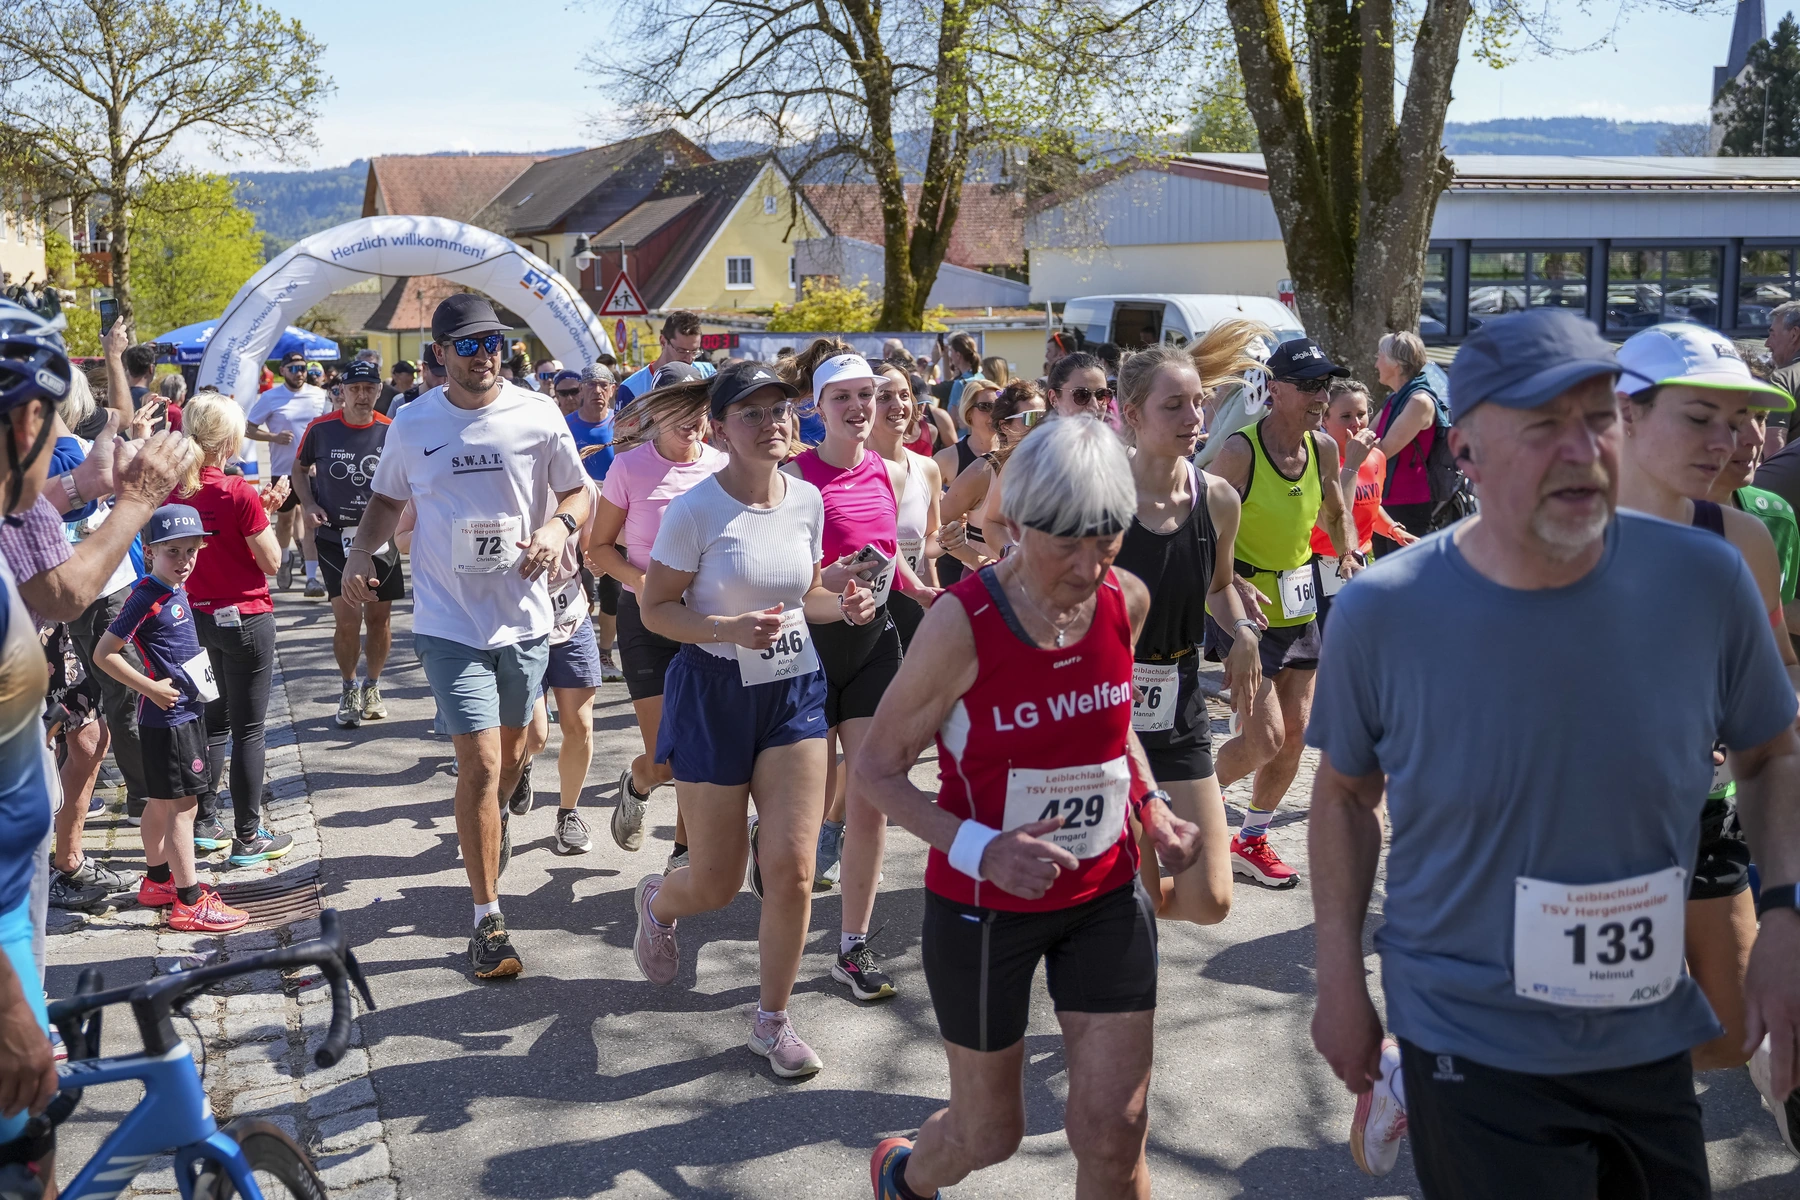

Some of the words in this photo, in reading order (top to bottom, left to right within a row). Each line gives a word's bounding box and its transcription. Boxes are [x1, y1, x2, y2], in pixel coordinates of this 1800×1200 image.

[331, 235, 387, 261] Herzlich
[391, 233, 486, 260] willkommen!
[556, 292, 588, 334] Volksbank
[215, 336, 238, 385] Volksbank
[330, 452, 355, 460] trophy
[452, 453, 503, 468] S.W.A.T.
[174, 517, 196, 526] FOX
[470, 521, 507, 529] Leiblachlauf
[476, 536, 502, 556] 72
[777, 658, 793, 666] Alina
[774, 667, 791, 677] AOK
[1133, 667, 1171, 675] eiblachlauf
[992, 702, 1040, 732] LG
[1047, 681, 1130, 721] Welfen
[1150, 721, 1163, 730] AOK
[1045, 770, 1106, 783] Leiblachlauf
[1026, 785, 1047, 795] TSV
[1050, 779, 1118, 794] Hergensweiler
[1038, 794, 1105, 829] 429
[1053, 831, 1087, 842] Irmgard
[1567, 882, 1649, 902] Leiblachlauf
[1540, 903, 1570, 916] TSV
[1575, 894, 1669, 917] Hergensweiler
[1563, 916, 1655, 965] 133
[1589, 969, 1635, 981] Helmut
[1629, 983, 1661, 1002] AOK
